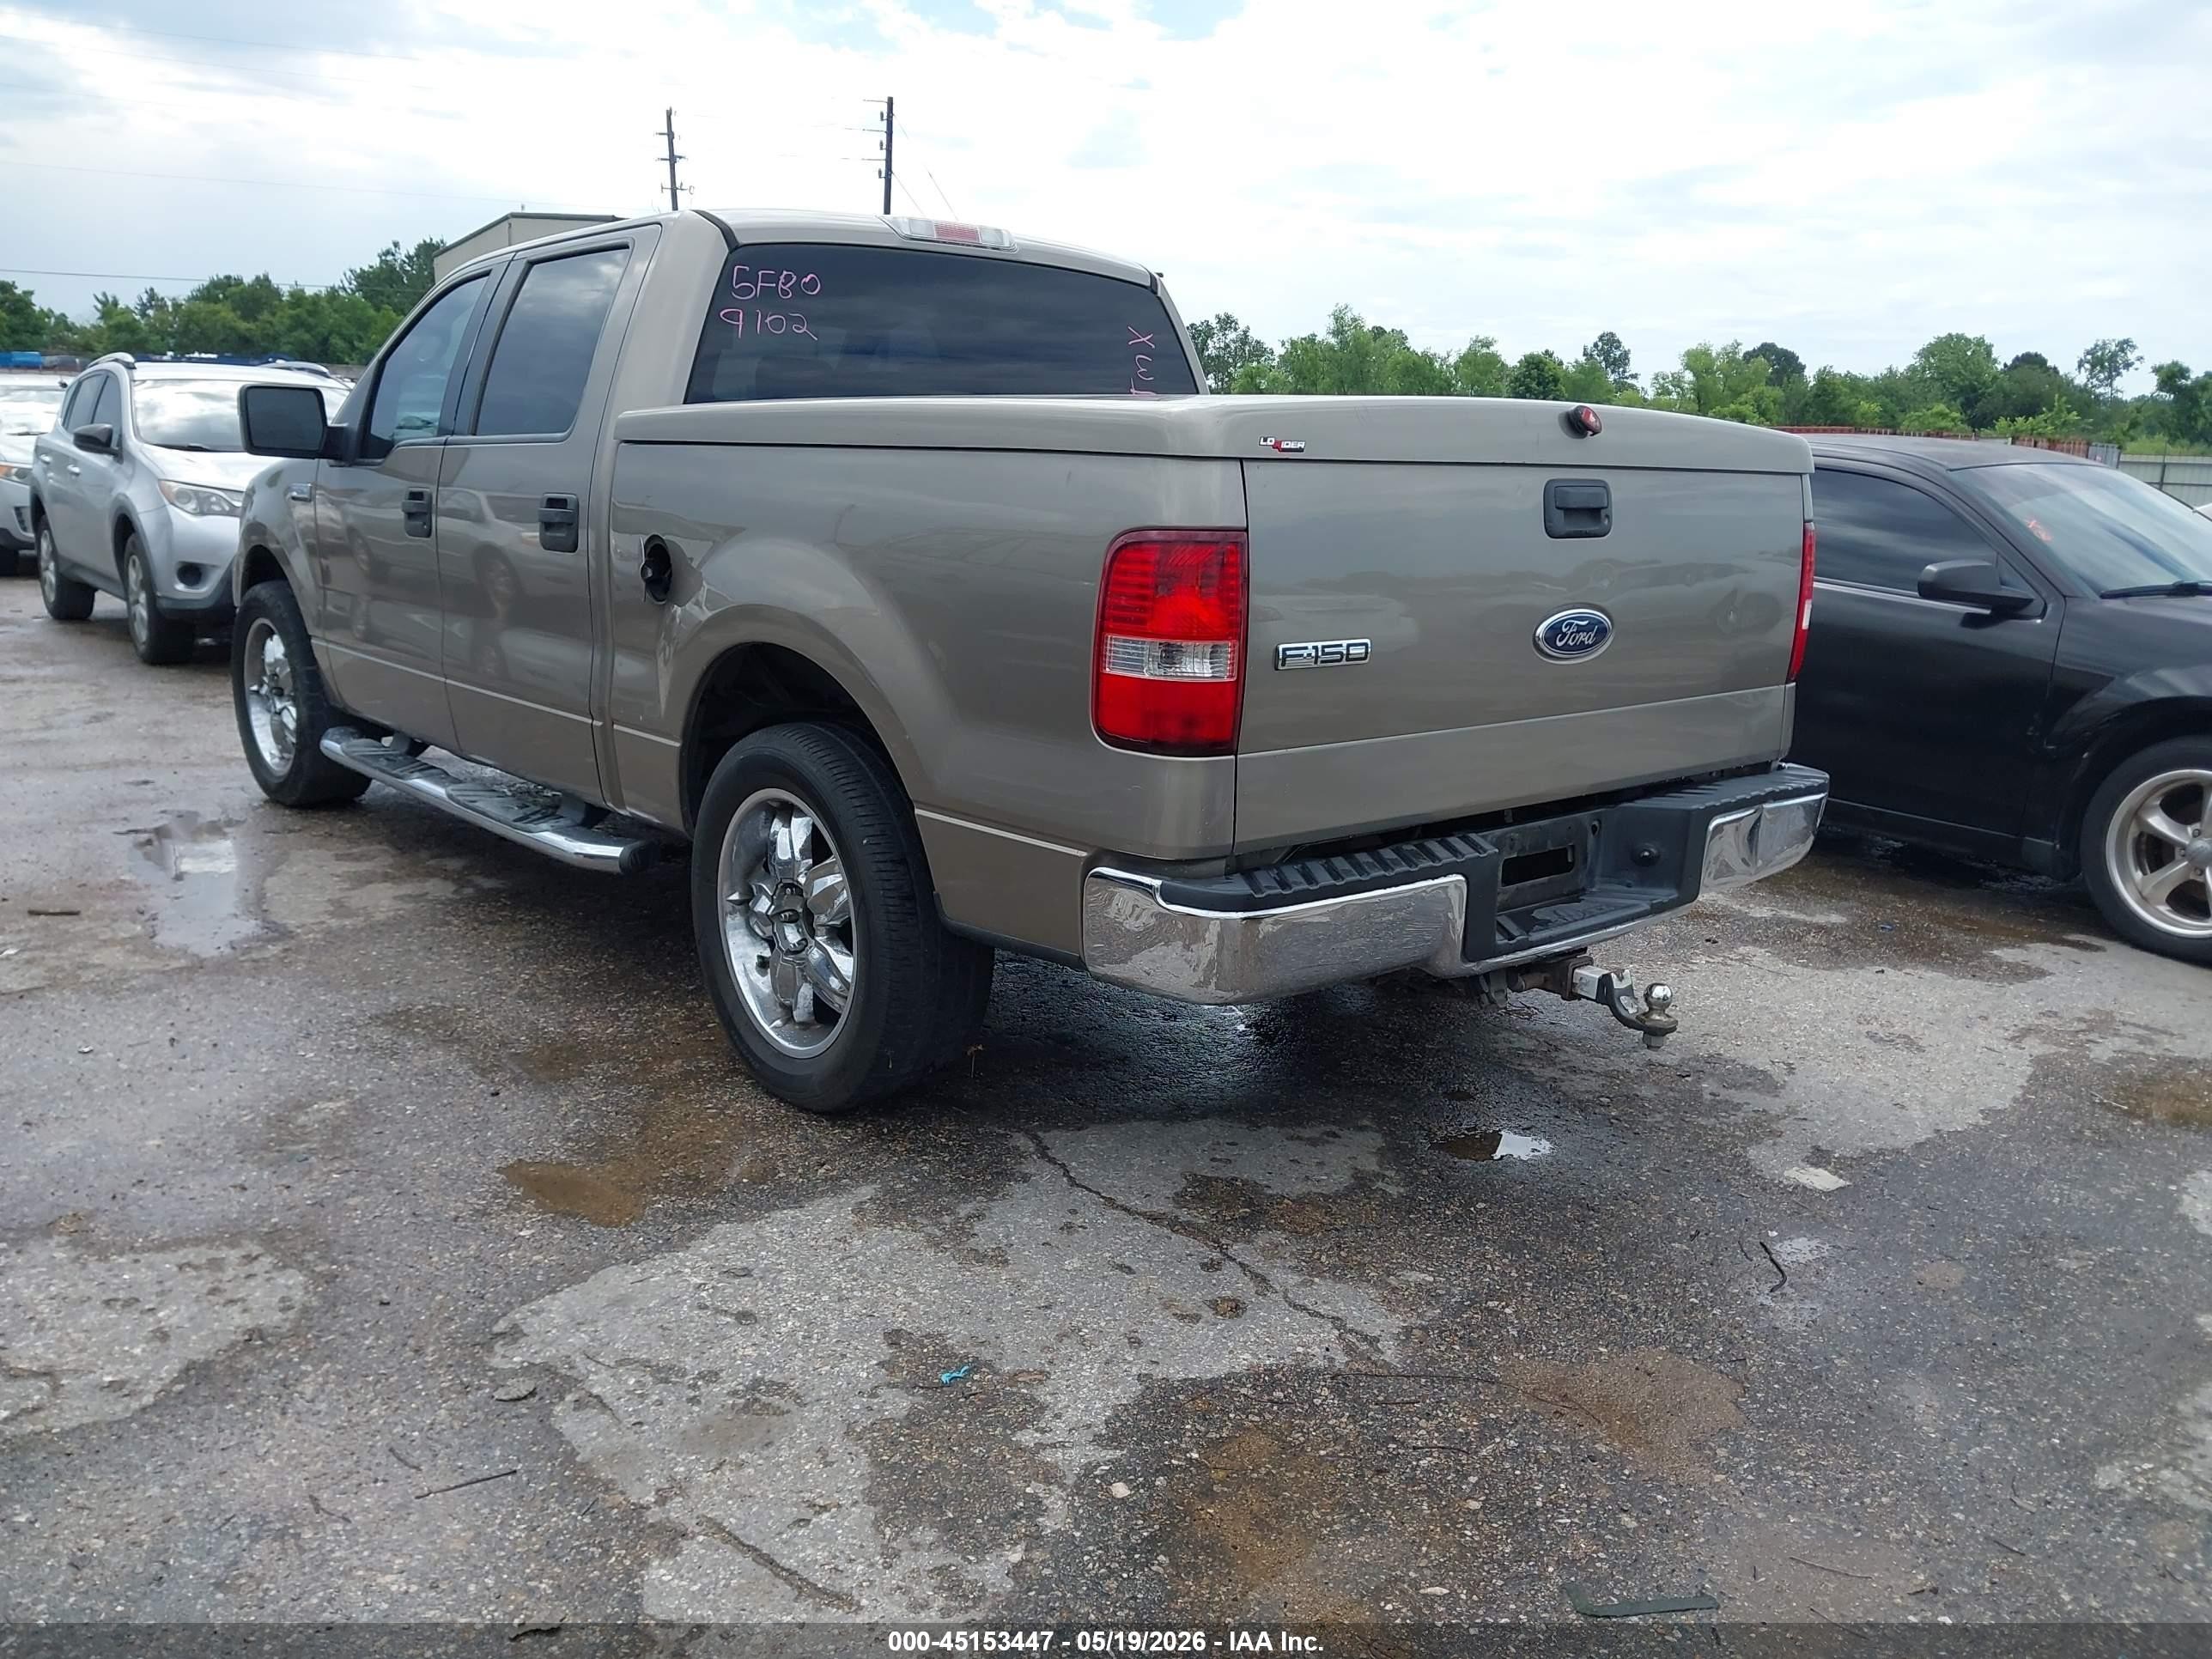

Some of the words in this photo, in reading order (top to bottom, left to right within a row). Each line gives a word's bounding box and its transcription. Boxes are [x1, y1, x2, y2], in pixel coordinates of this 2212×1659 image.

[720, 308, 818, 341] 9102
[1556, 619, 1598, 647] Ford
[1280, 641, 1370, 667] F-150
